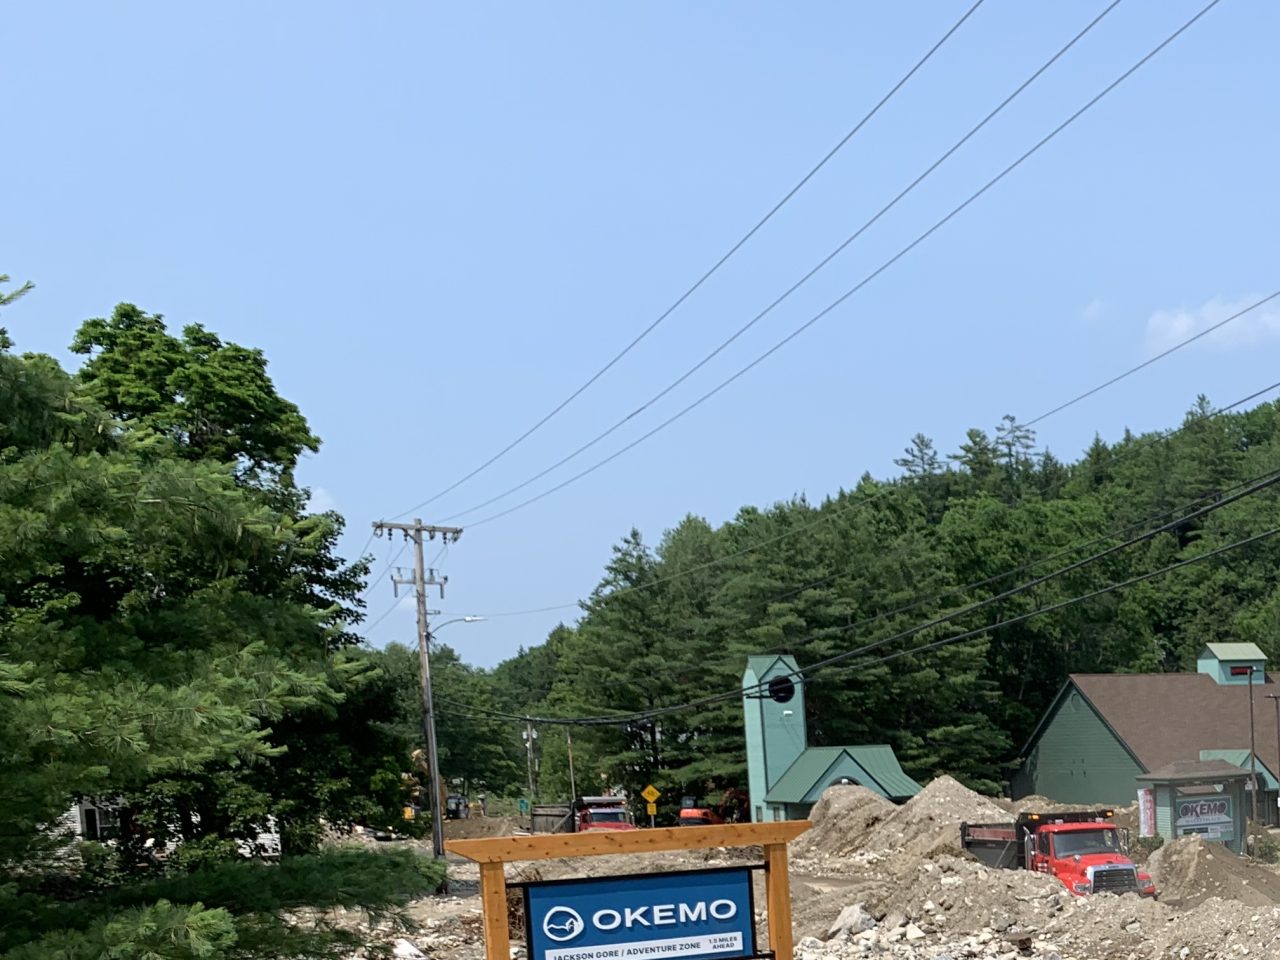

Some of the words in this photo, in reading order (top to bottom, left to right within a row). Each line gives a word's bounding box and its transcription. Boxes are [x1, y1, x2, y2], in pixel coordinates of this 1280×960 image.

[1180, 801, 1227, 817] OKEMO
[592, 899, 737, 930] OKEMO
[596, 949, 619, 959] GORE
[626, 944, 678, 956] ADVENTURE
[679, 942, 701, 951] ZONE
